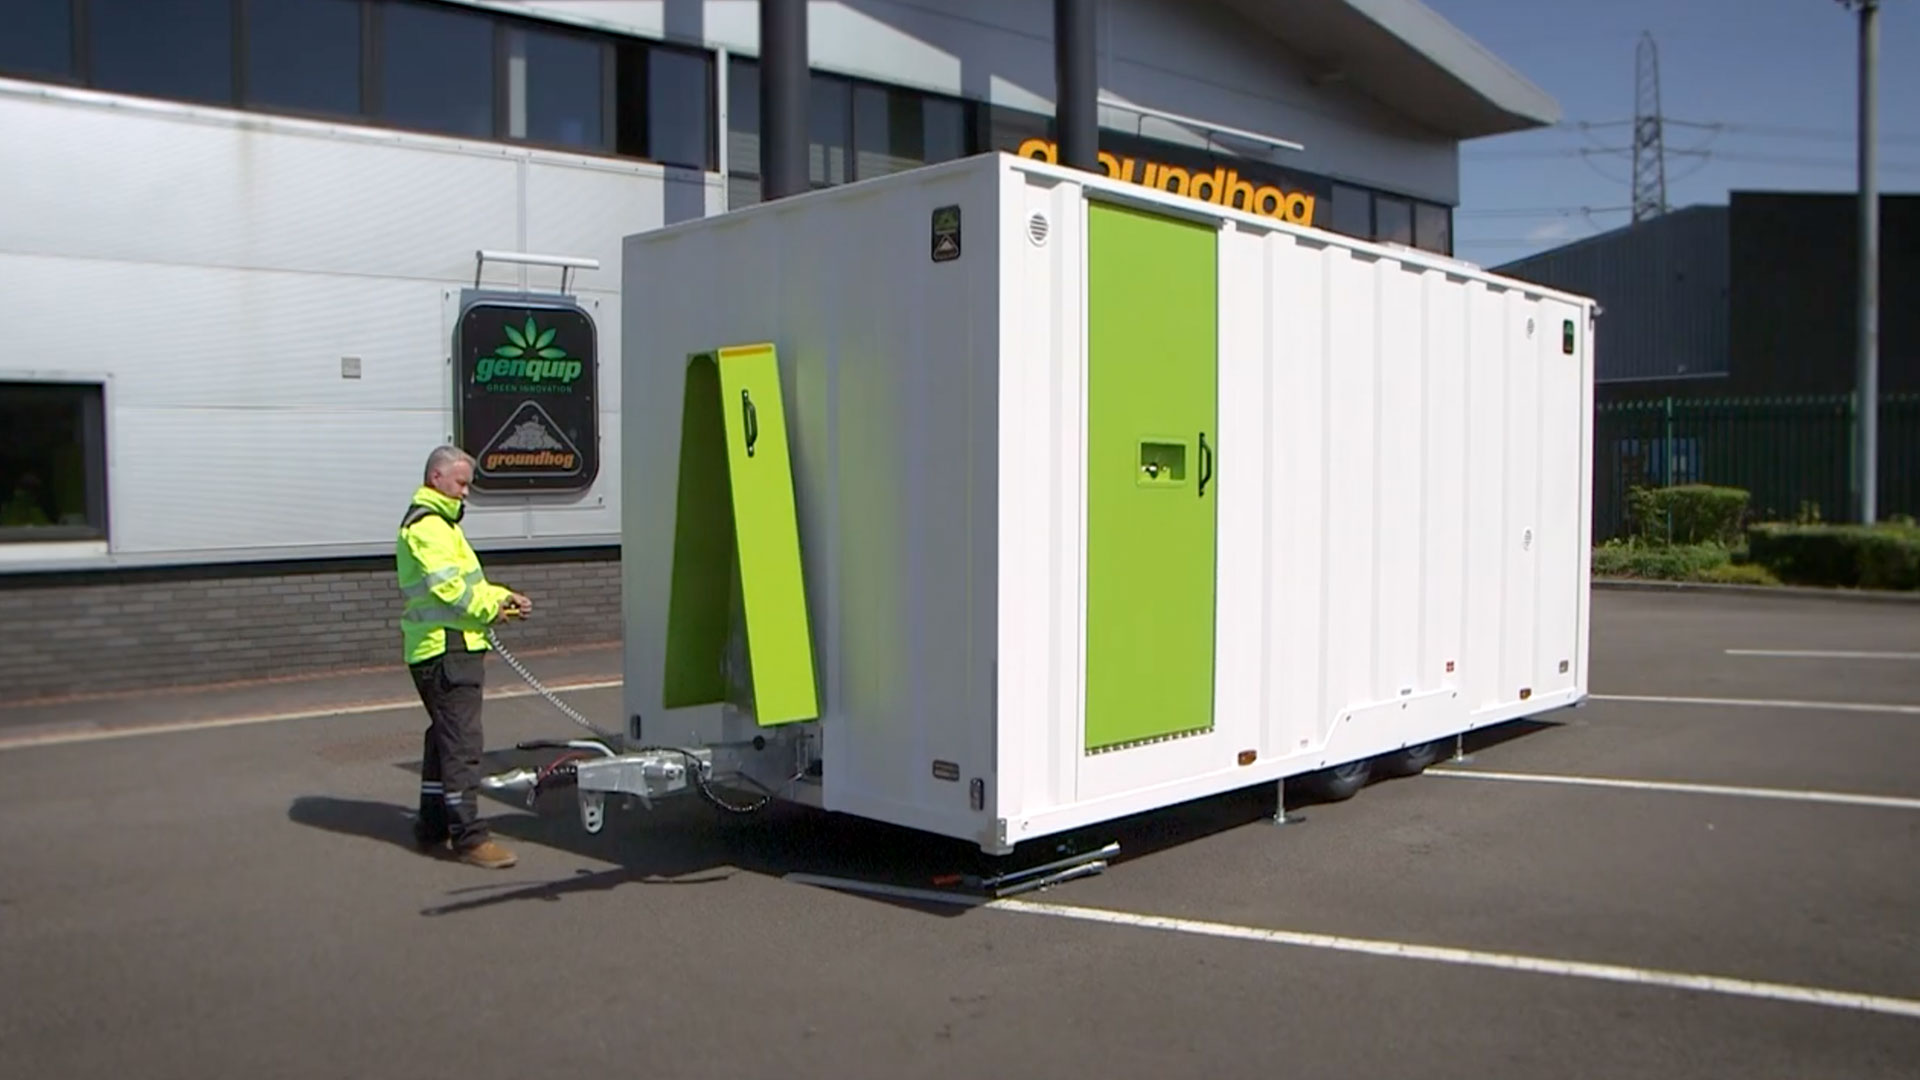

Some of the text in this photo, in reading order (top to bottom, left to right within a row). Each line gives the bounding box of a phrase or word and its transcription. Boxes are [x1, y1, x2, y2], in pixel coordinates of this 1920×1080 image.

[1018, 138, 1315, 228] undhog
[476, 358, 582, 383] genquip
[486, 384, 573, 394] GREEN INNOVATION
[486, 451, 575, 469] groundhog
